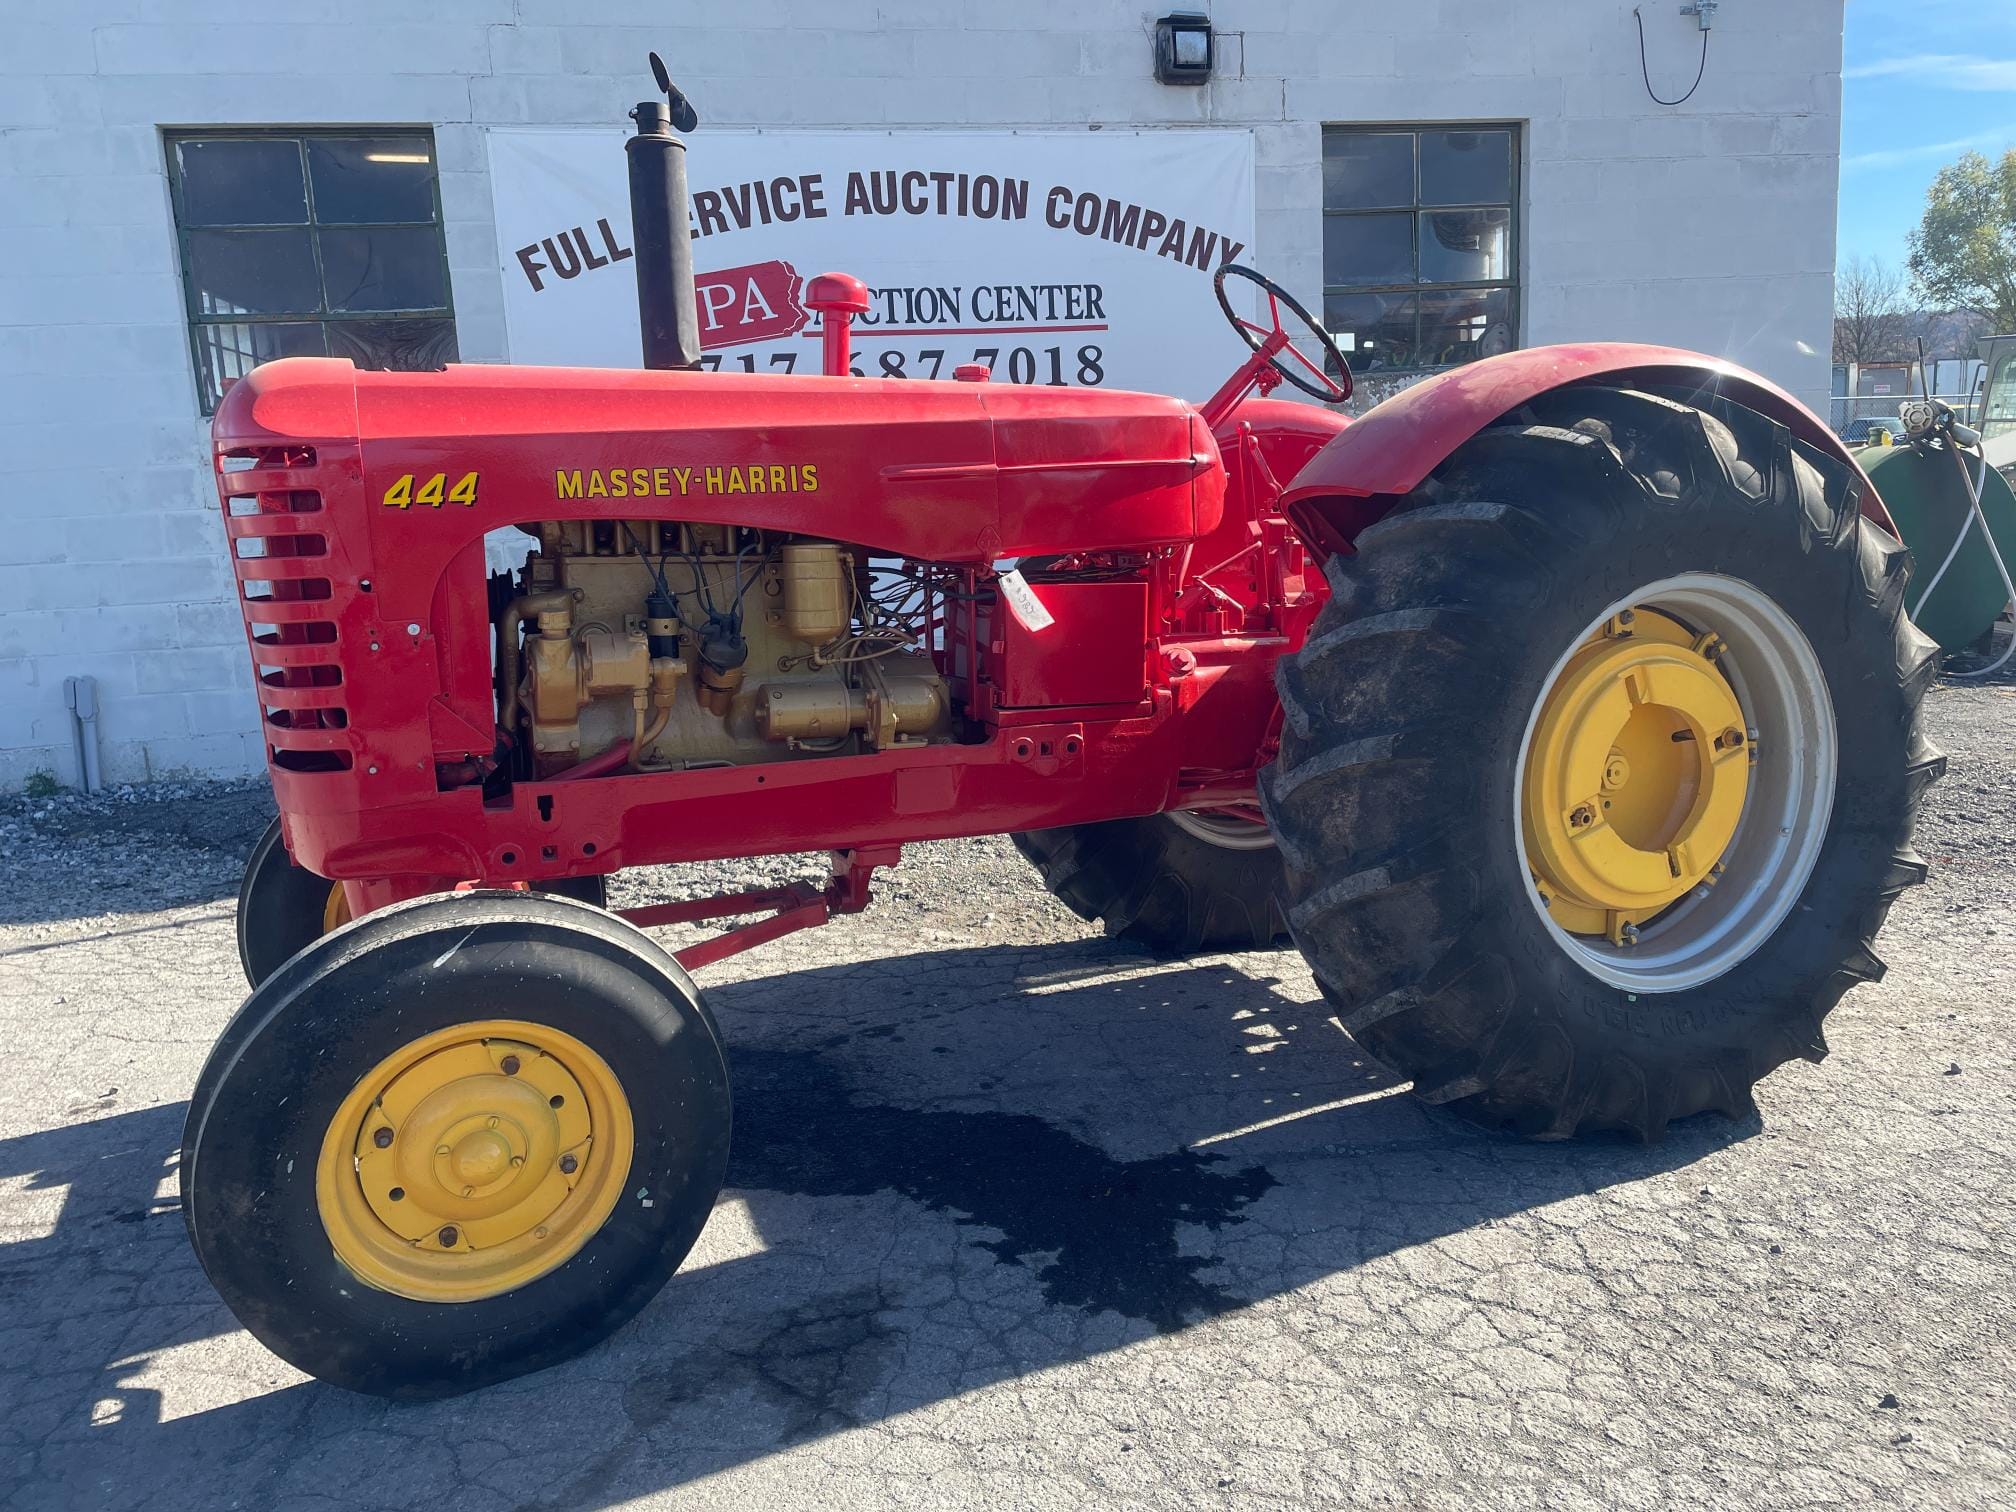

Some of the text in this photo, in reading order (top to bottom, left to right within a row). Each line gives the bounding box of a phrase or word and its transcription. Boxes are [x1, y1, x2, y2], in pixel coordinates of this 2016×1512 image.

[515, 170, 1245, 292] FULL RVICE AUCTION COMPANY
[696, 276, 1106, 331] PA CTION CENTER
[383, 463, 819, 509] 444 MASSEY-HARRIS
